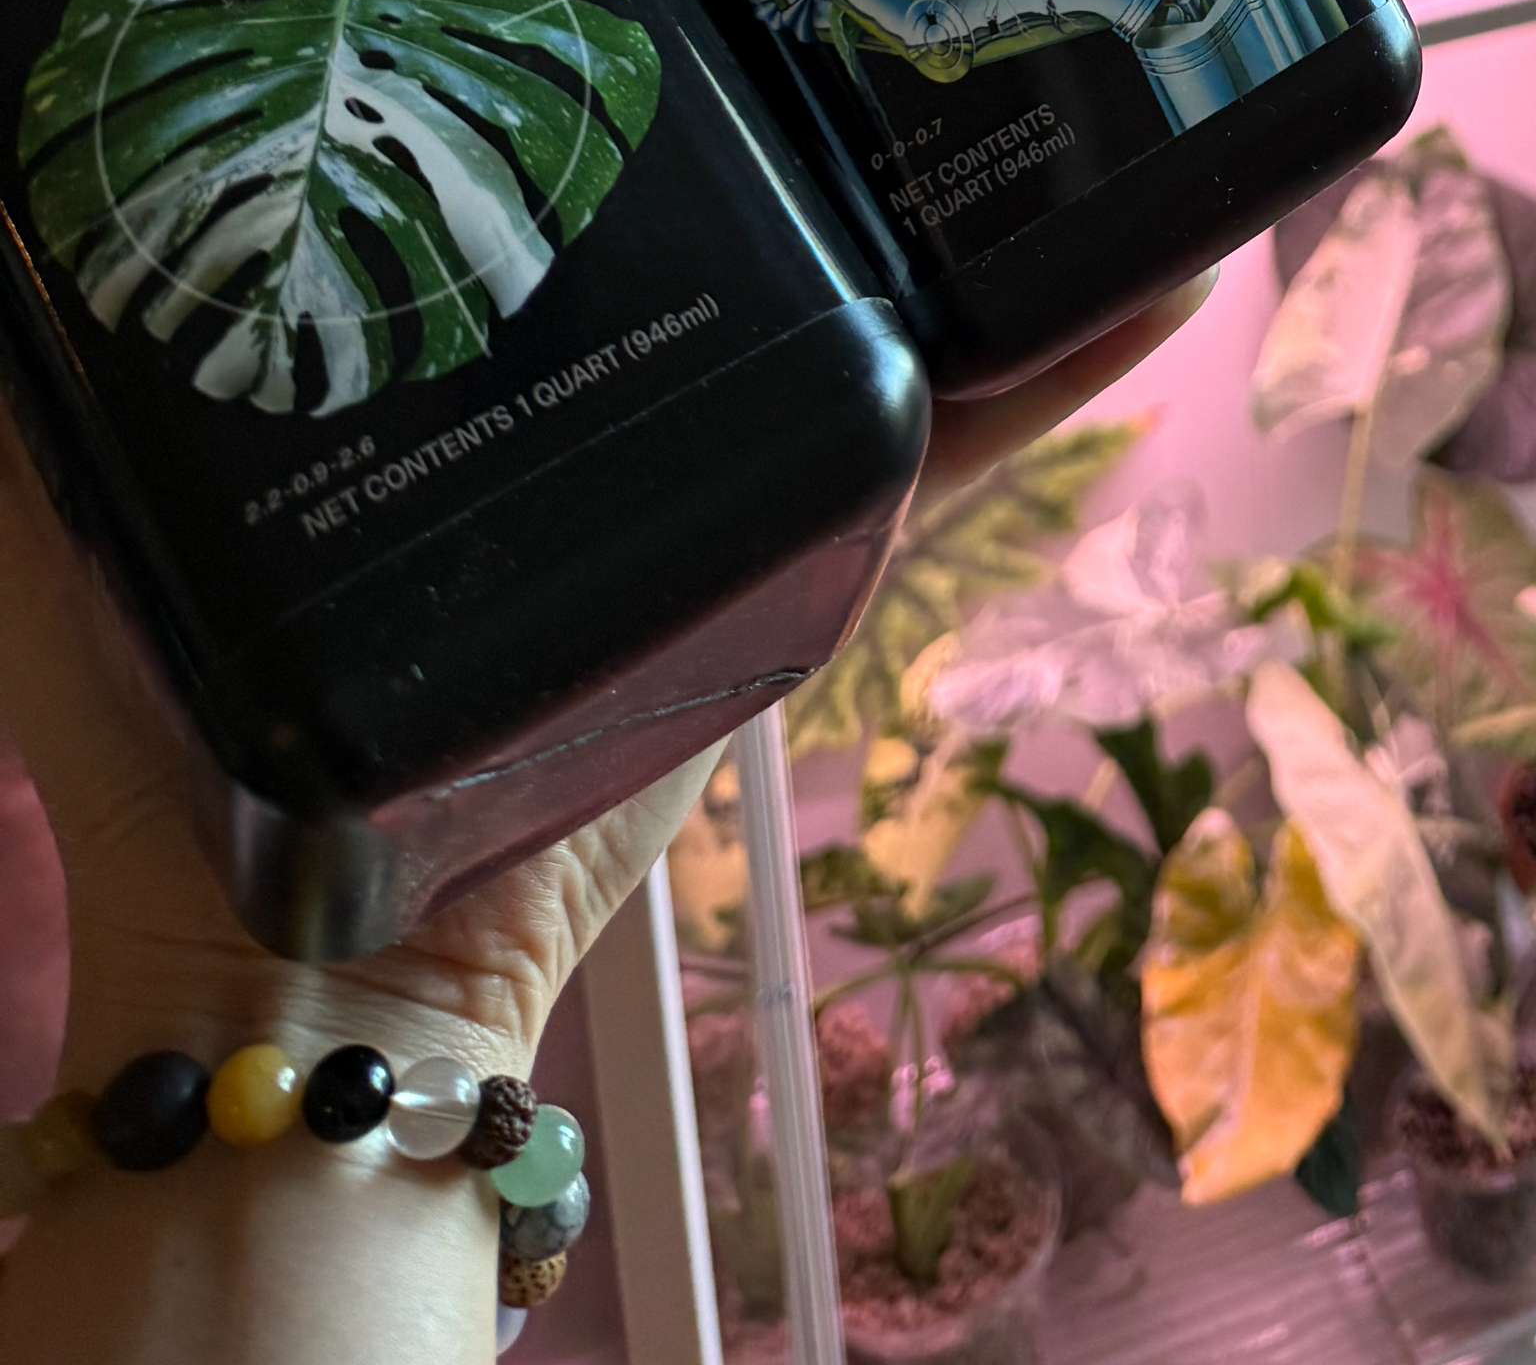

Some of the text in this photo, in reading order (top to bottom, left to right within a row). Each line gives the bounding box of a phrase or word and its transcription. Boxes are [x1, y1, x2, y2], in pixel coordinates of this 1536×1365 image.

[870, 117, 943, 171] 0-0-0.7
[888, 103, 1056, 214] NET CONTENTS
[902, 121, 1076, 237] 1 QUART (946ml)
[298, 291, 721, 540] NET CONTENTS 1 QUART (946ml)
